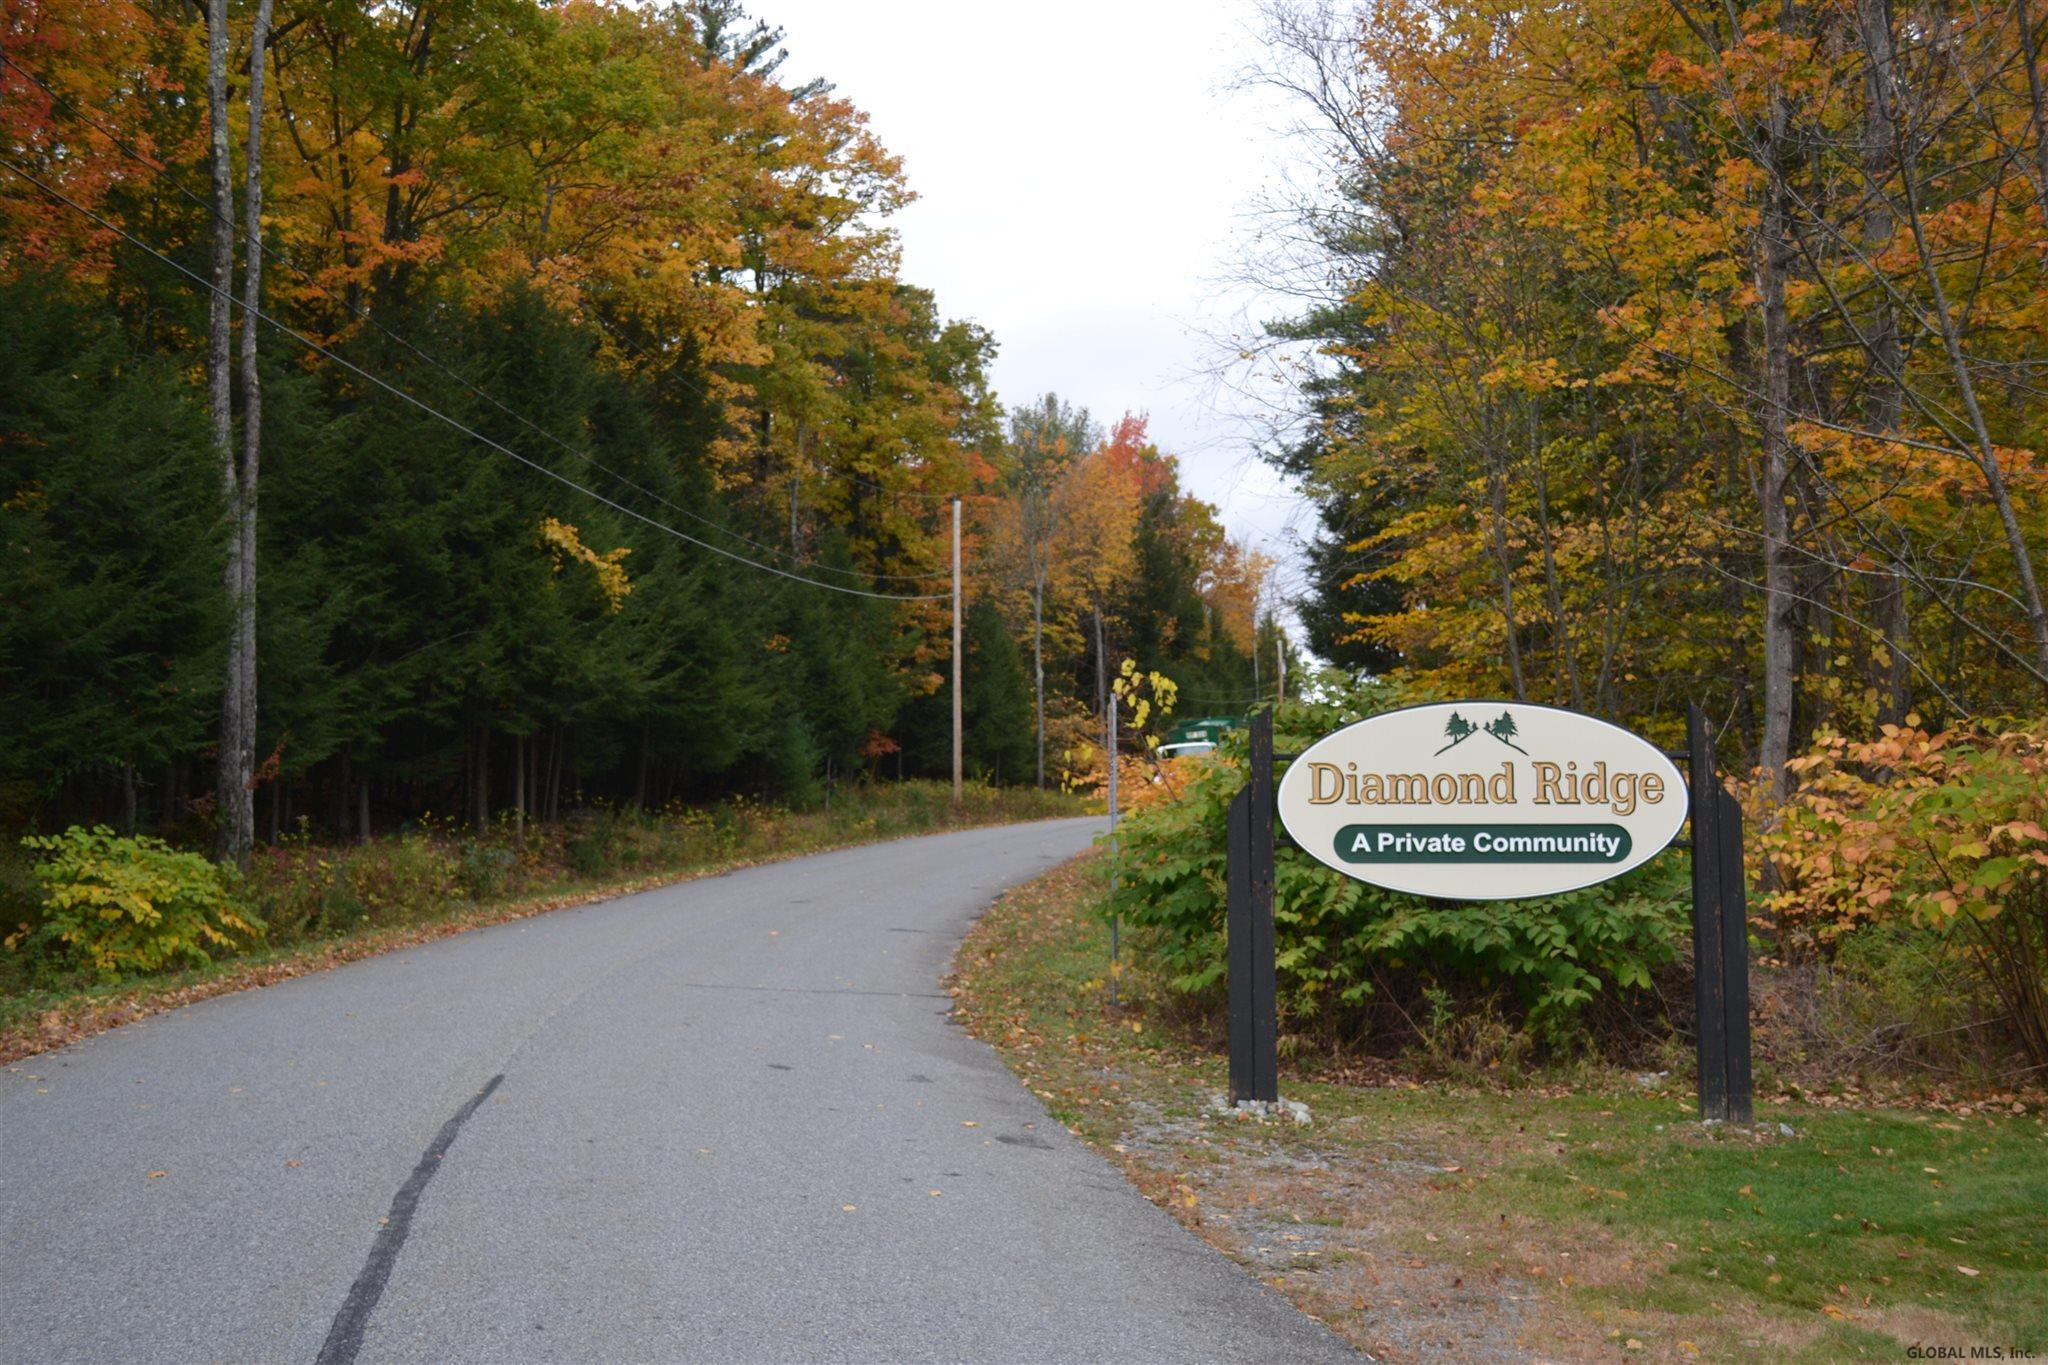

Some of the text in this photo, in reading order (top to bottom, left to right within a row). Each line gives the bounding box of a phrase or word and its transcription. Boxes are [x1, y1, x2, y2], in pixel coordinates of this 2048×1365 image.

[1308, 761, 1665, 816] Diamond Ridge
[1350, 832, 1621, 857] A Private Community
